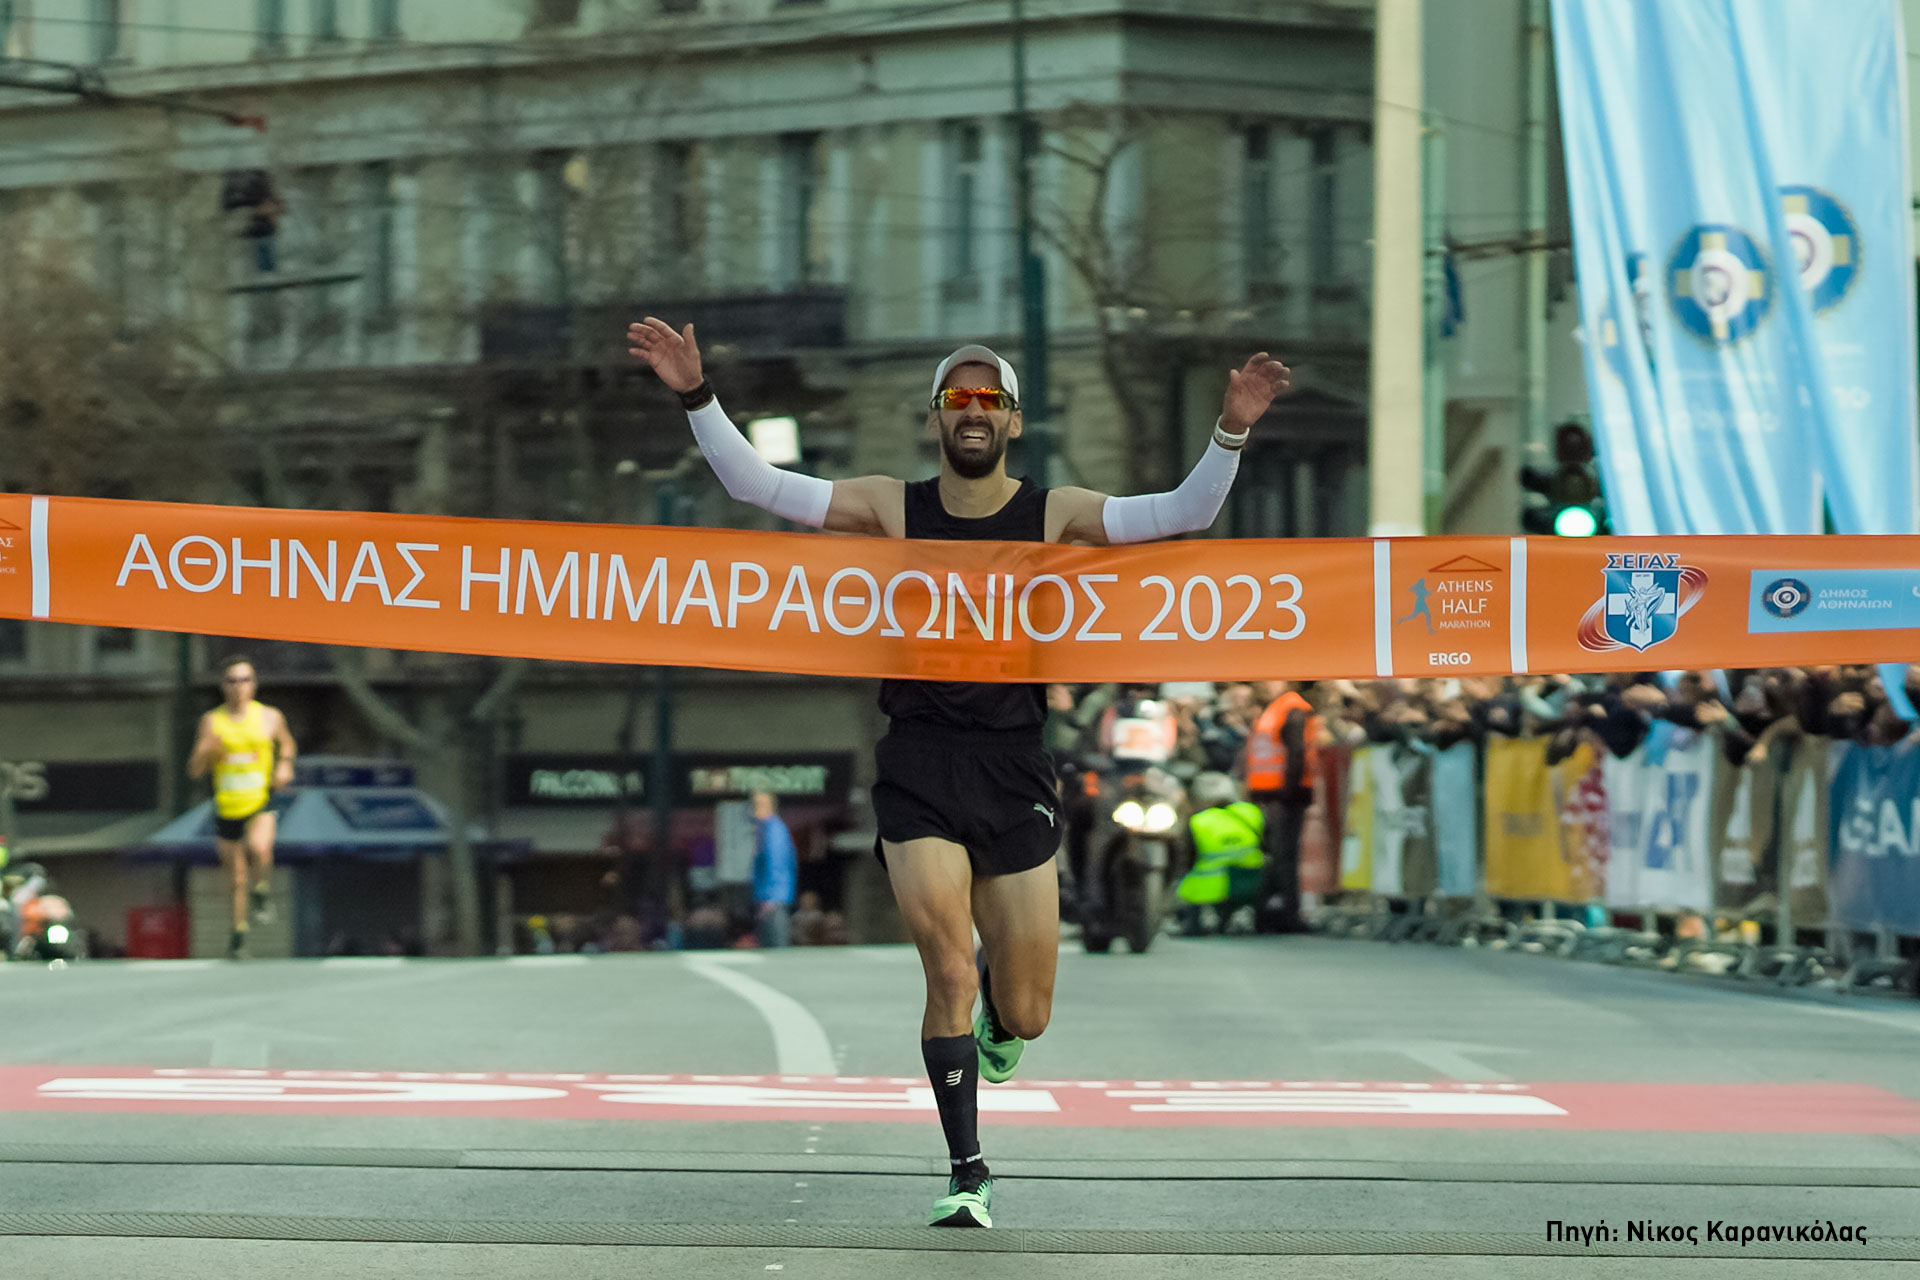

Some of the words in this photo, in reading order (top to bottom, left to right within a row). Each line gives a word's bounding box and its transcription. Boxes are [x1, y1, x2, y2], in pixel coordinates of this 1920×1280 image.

[1606, 553, 1681, 570] ΣΕΓΑΣ
[115, 533, 441, 609] ΑΘΗΝΑΣ
[460, 545, 1122, 643] ΗΜΙΜΑΡΑΘΩΝΙΟΣ
[1138, 573, 1307, 642] 2023
[1436, 579, 1494, 593] ATHENS
[1818, 588, 1868, 598] ΔΗΜΟΣ
[1441, 597, 1488, 615] HALF
[1817, 599, 1893, 610] ΑΘΗΝΑΙΩΝ
[1439, 619, 1491, 630] MARATHON
[1428, 651, 1472, 667] ERGO
